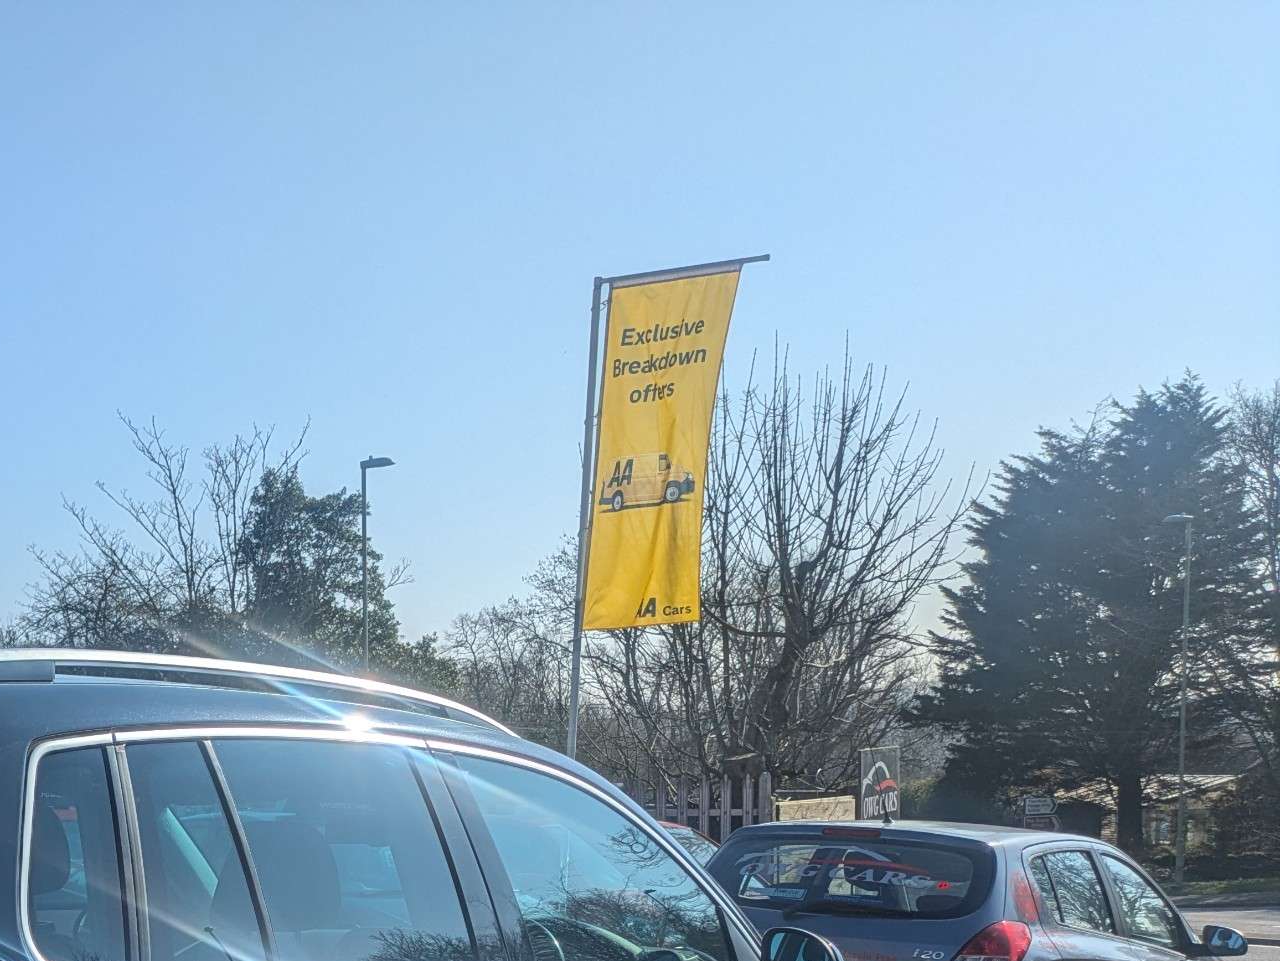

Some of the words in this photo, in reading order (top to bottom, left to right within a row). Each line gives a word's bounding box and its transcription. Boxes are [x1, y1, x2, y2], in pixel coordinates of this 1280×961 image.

[621, 319, 705, 346] Exclusive
[613, 348, 707, 378] Breakdown
[607, 459, 634, 489] AA
[662, 604, 692, 616] Cars
[863, 794, 880, 820] OWG
[912, 948, 945, 960] i20
